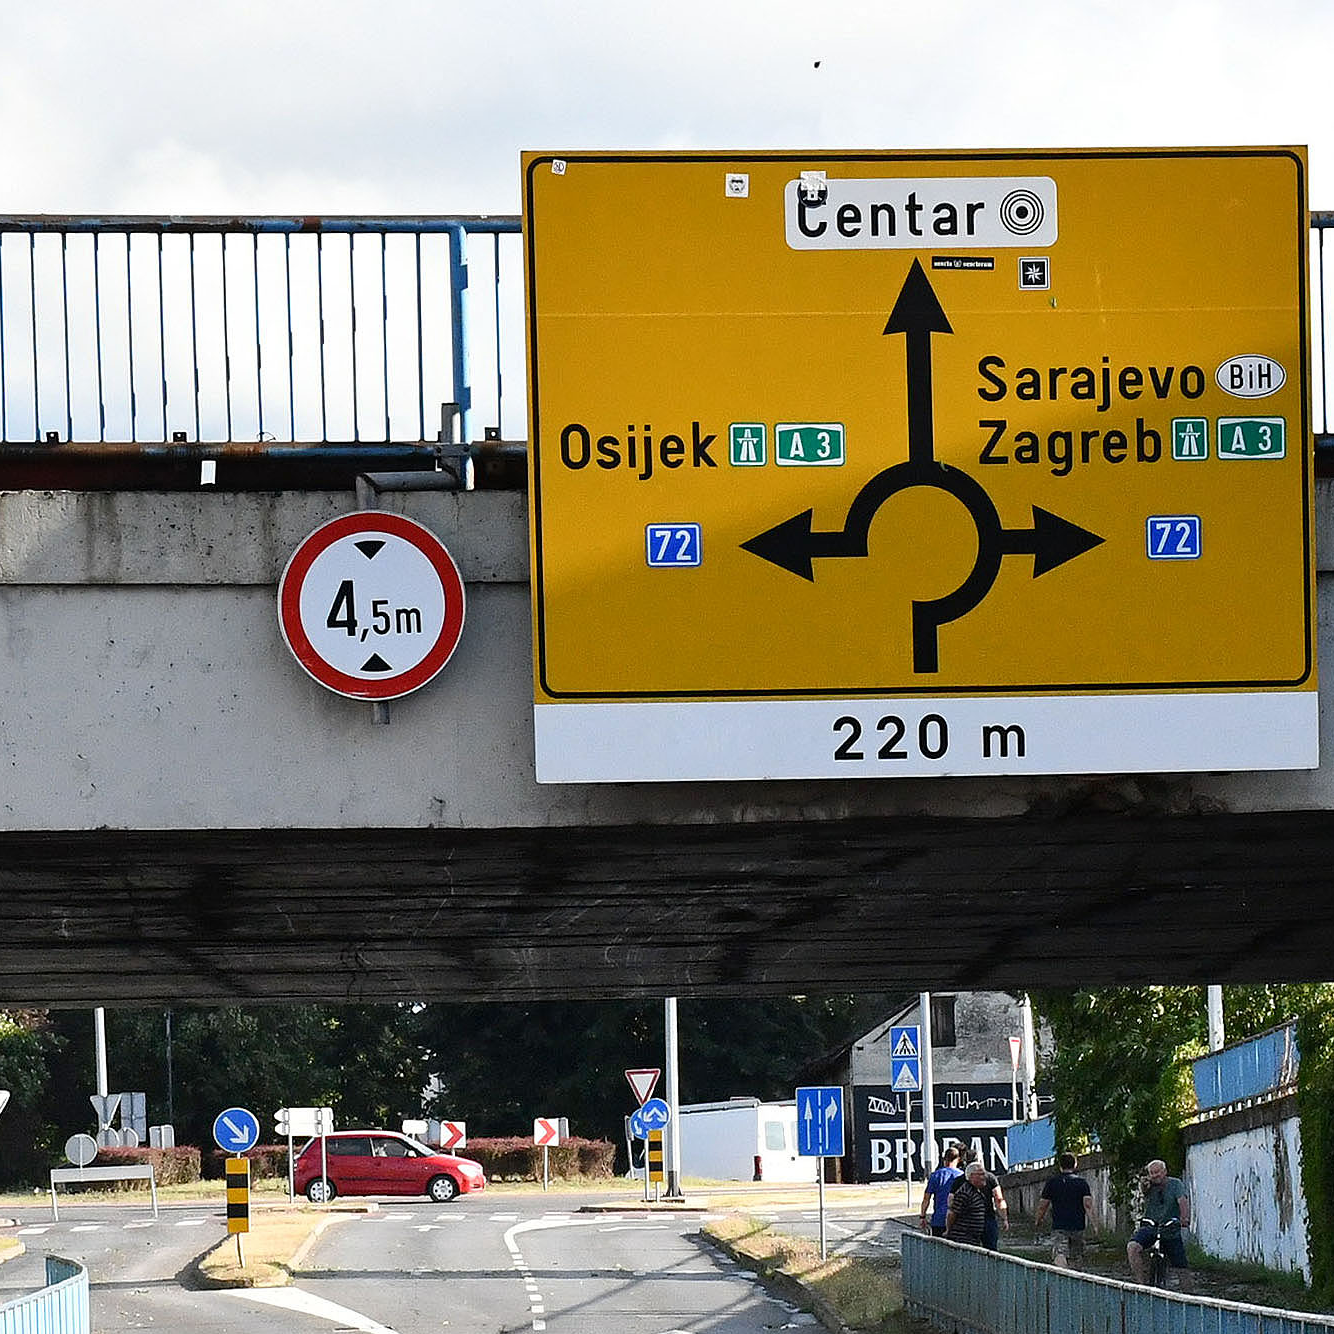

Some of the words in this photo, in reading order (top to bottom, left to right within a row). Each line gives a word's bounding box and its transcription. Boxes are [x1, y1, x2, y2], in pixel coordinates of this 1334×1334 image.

[797, 190, 986, 238] Centar
[977, 355, 1205, 412] Sarajevo
[1229, 363, 1272, 389] BiH
[560, 421, 718, 481] Osijek
[977, 417, 1163, 477] Zagreb
[654, 530, 692, 561] 72
[1154, 522, 1192, 553] 72
[832, 713, 949, 760] 220
[982, 724, 1026, 758] m
